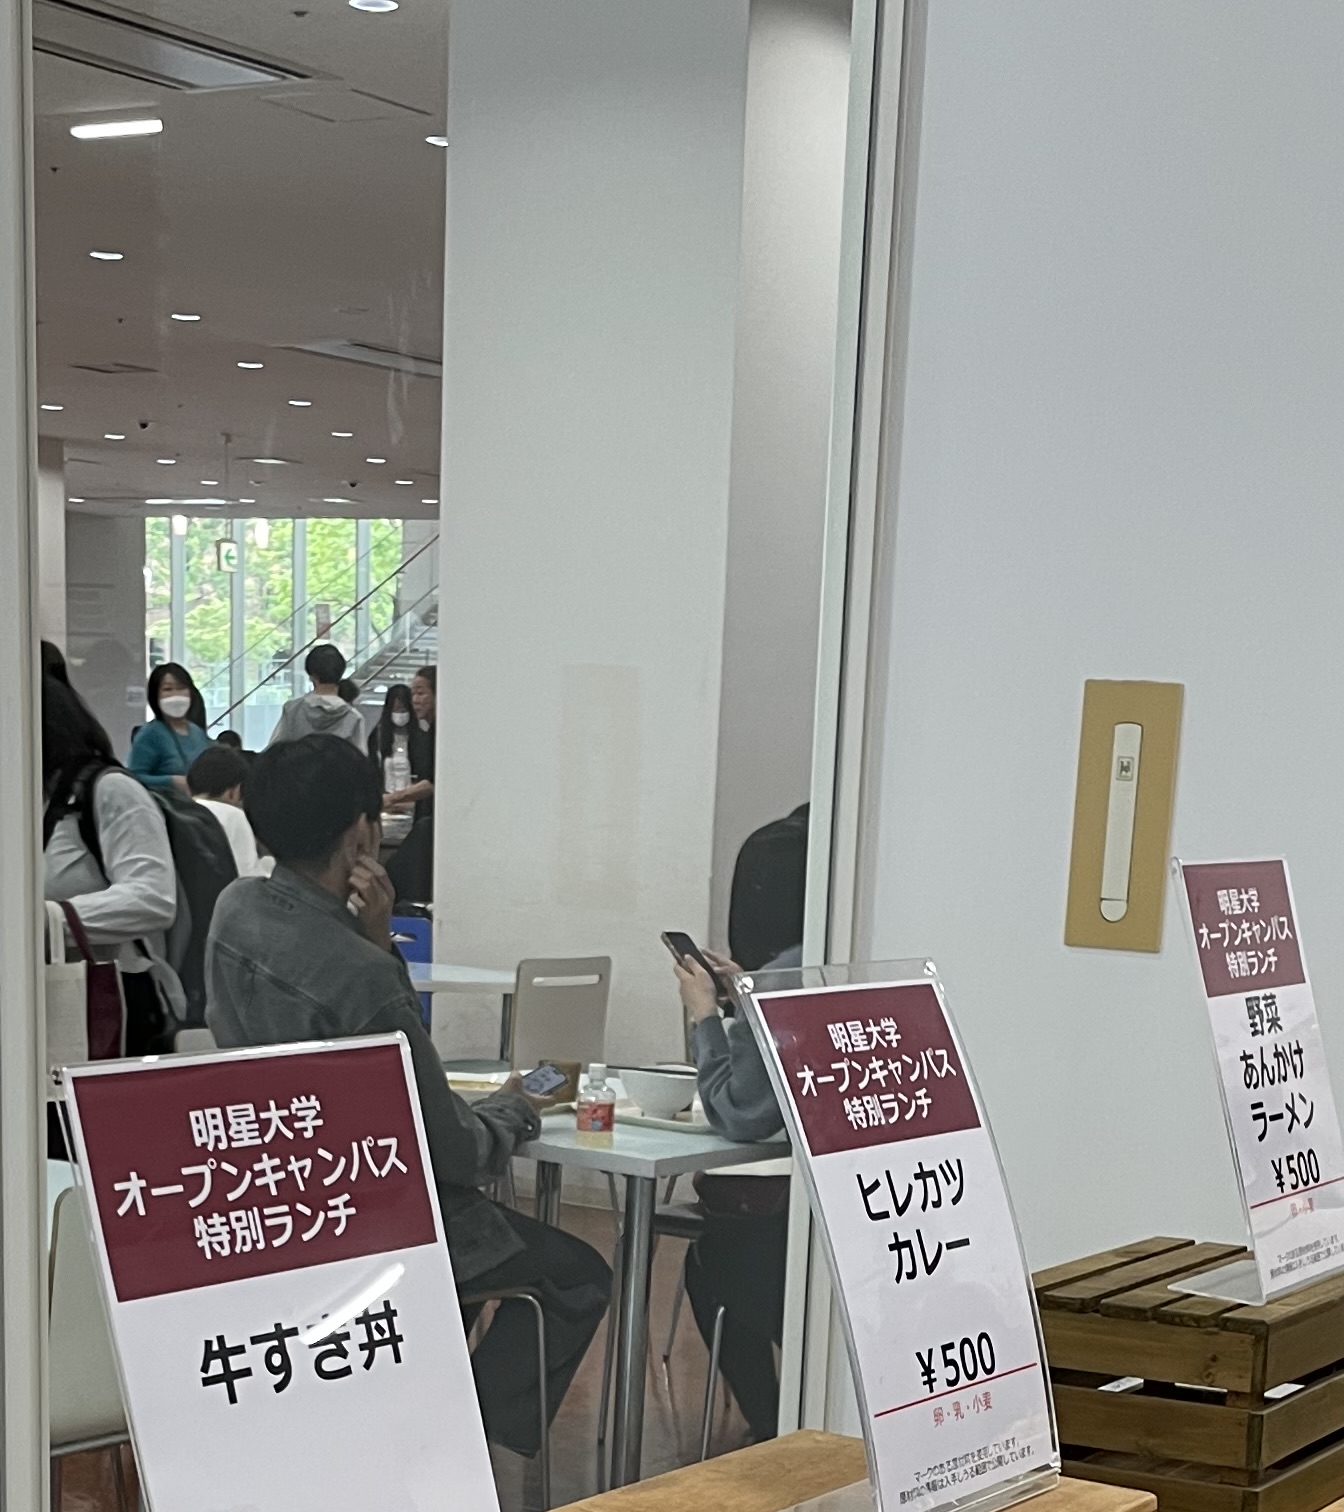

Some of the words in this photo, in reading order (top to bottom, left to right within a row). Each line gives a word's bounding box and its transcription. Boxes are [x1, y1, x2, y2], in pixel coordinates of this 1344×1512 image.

[1217, 887, 1260, 915] 明星大学
[1199, 915, 1293, 950] オープンキャンパス
[1226, 948, 1278, 978] 特別ランチ
[827, 1017, 902, 1053] 明星大学
[1245, 993, 1283, 1037] 野菜
[796, 1047, 958, 1097] オープンキャンパス
[1240, 1040, 1304, 1090] あんかけ
[188, 1095, 324, 1152] 明星大学
[843, 1088, 933, 1130] 特別ランチ
[1250, 1092, 1314, 1142] ラーメン
[113, 1136, 409, 1217] オープンキャンパス
[855, 1158, 965, 1222] ヒレカツ
[1271, 1148, 1320, 1193] ¥500
[192, 1192, 357, 1261] 特別ランチ
[887, 1228, 971, 1285] カレー
[915, 1331, 996, 1394] ¥500
